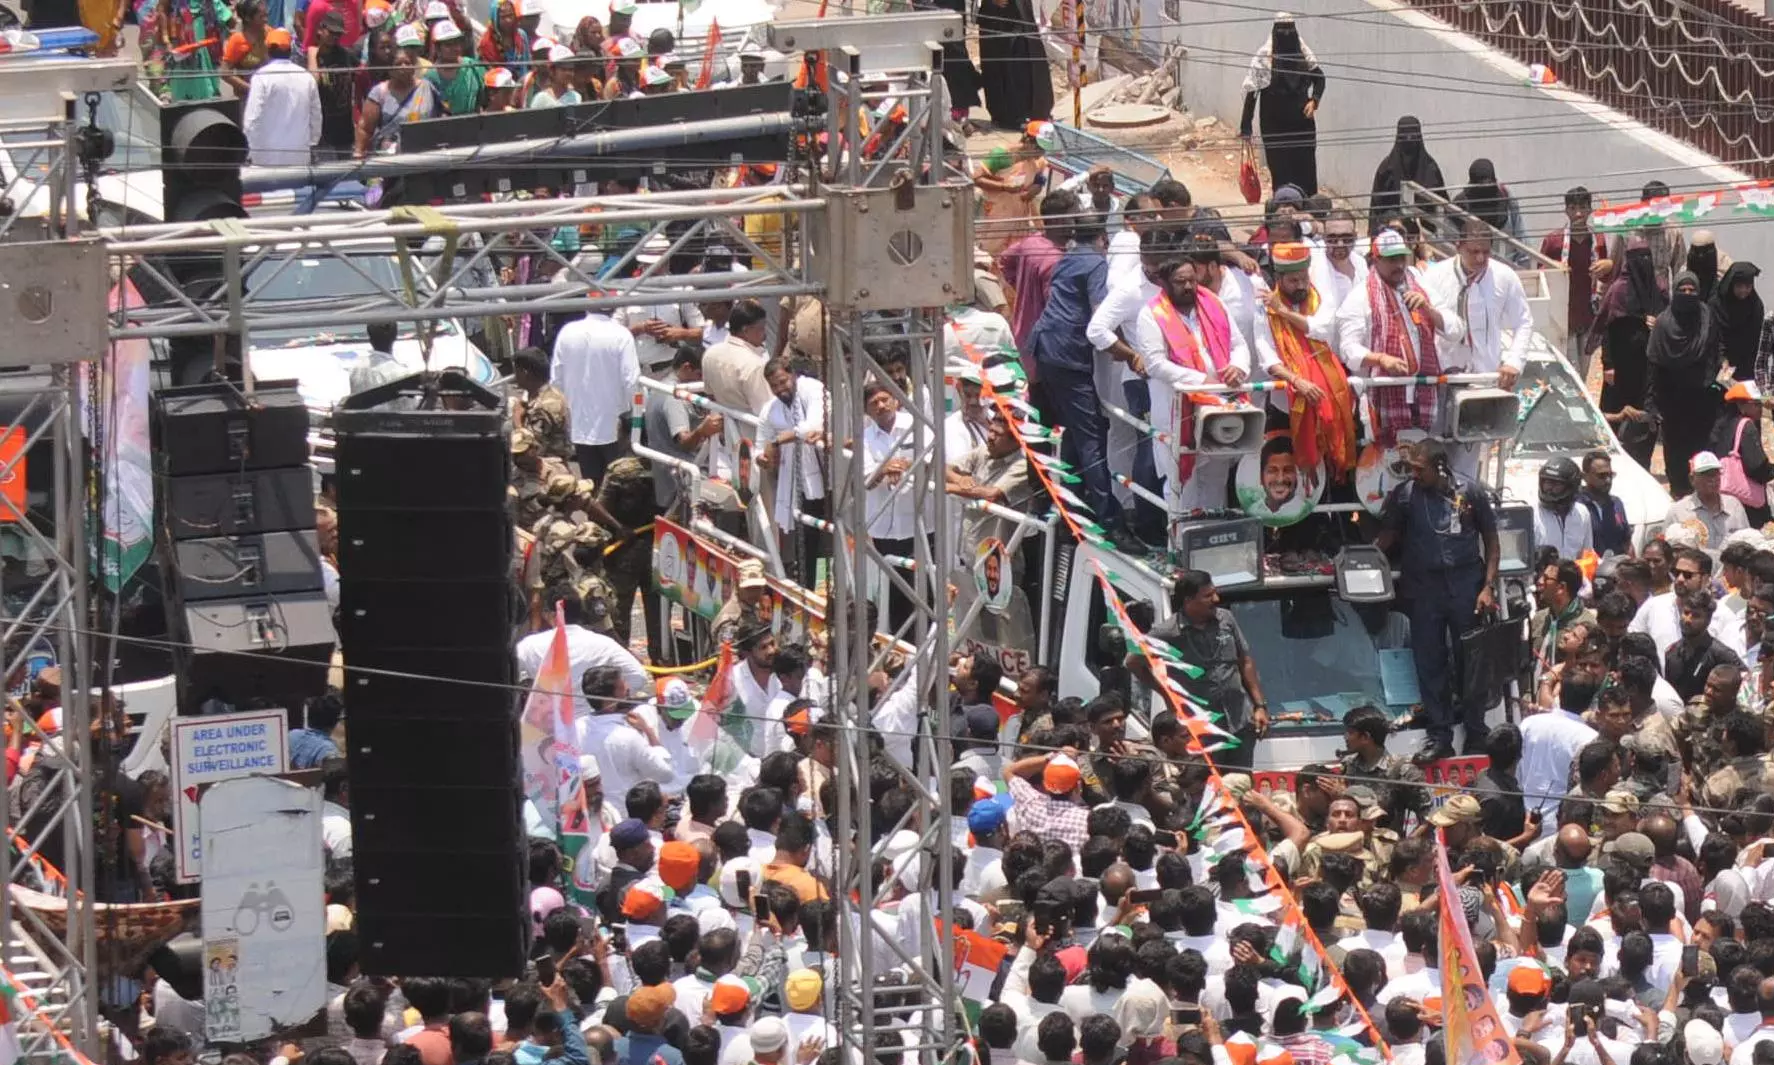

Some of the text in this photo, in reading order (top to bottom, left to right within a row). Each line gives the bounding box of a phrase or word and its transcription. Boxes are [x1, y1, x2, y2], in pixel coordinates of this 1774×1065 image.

[193, 723, 267, 740] AREA UNDER
[193, 739, 266, 757] ELECTRONIC
[187, 754, 275, 773] SURVEILLANCE
